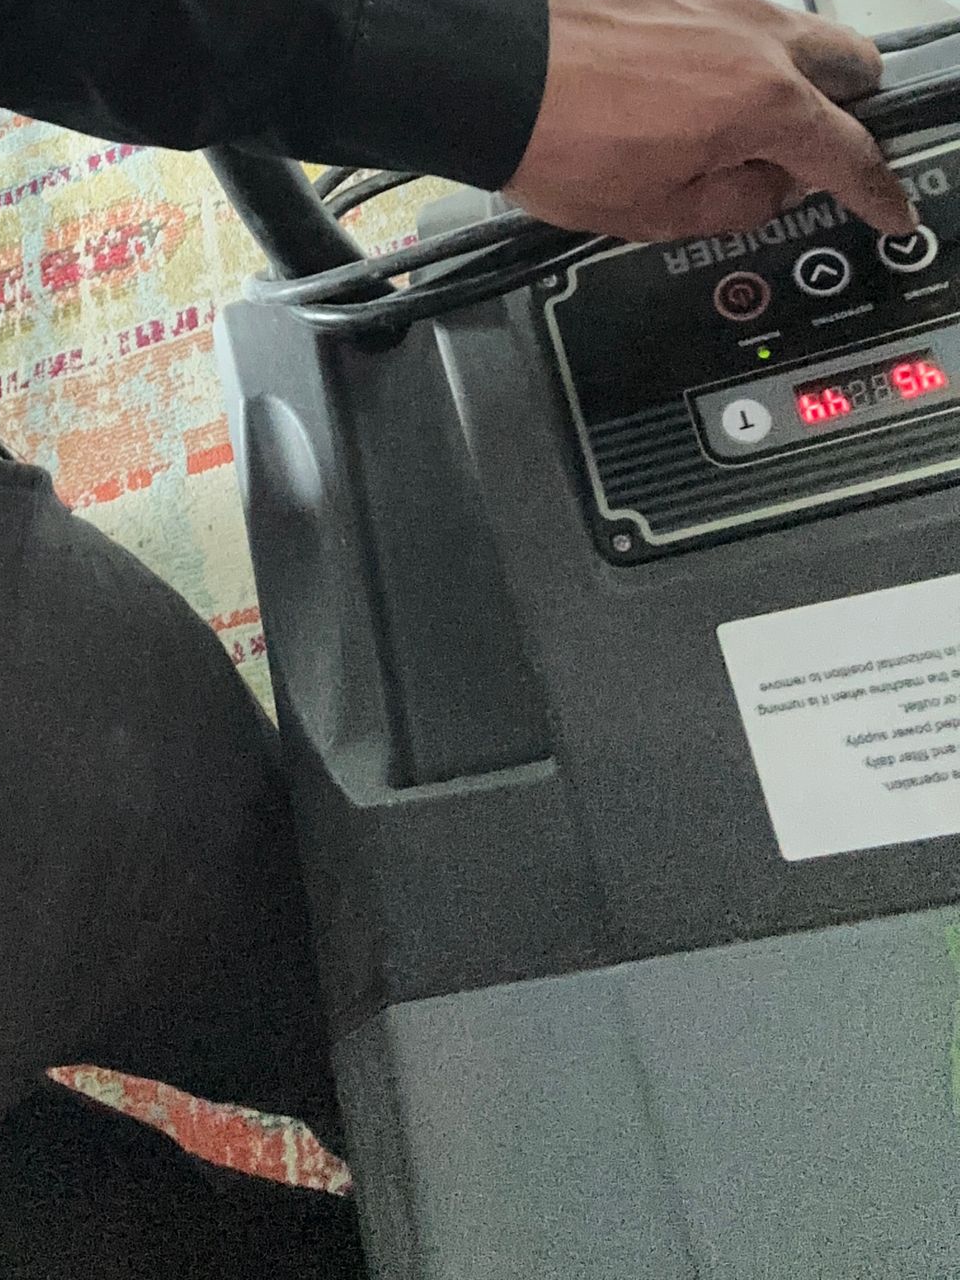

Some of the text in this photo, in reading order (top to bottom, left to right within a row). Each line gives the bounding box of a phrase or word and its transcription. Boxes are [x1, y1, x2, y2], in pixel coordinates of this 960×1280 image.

[797, 361, 946, 424] 45 44
[740, 411, 754, 430] T
[876, 649, 942, 671] horizontal
[809, 672, 822, 683] to
[823, 661, 874, 680] position
[928, 672, 950, 683] the
[759, 676, 806, 692] remove
[869, 677, 925, 694] machine
[807, 696, 819, 707] is
[821, 694, 830, 706] it
[832, 688, 867, 702] when
[892, 721, 933, 739] power
[899, 749, 929, 763] filter
[930, 745, 956, 759] and
